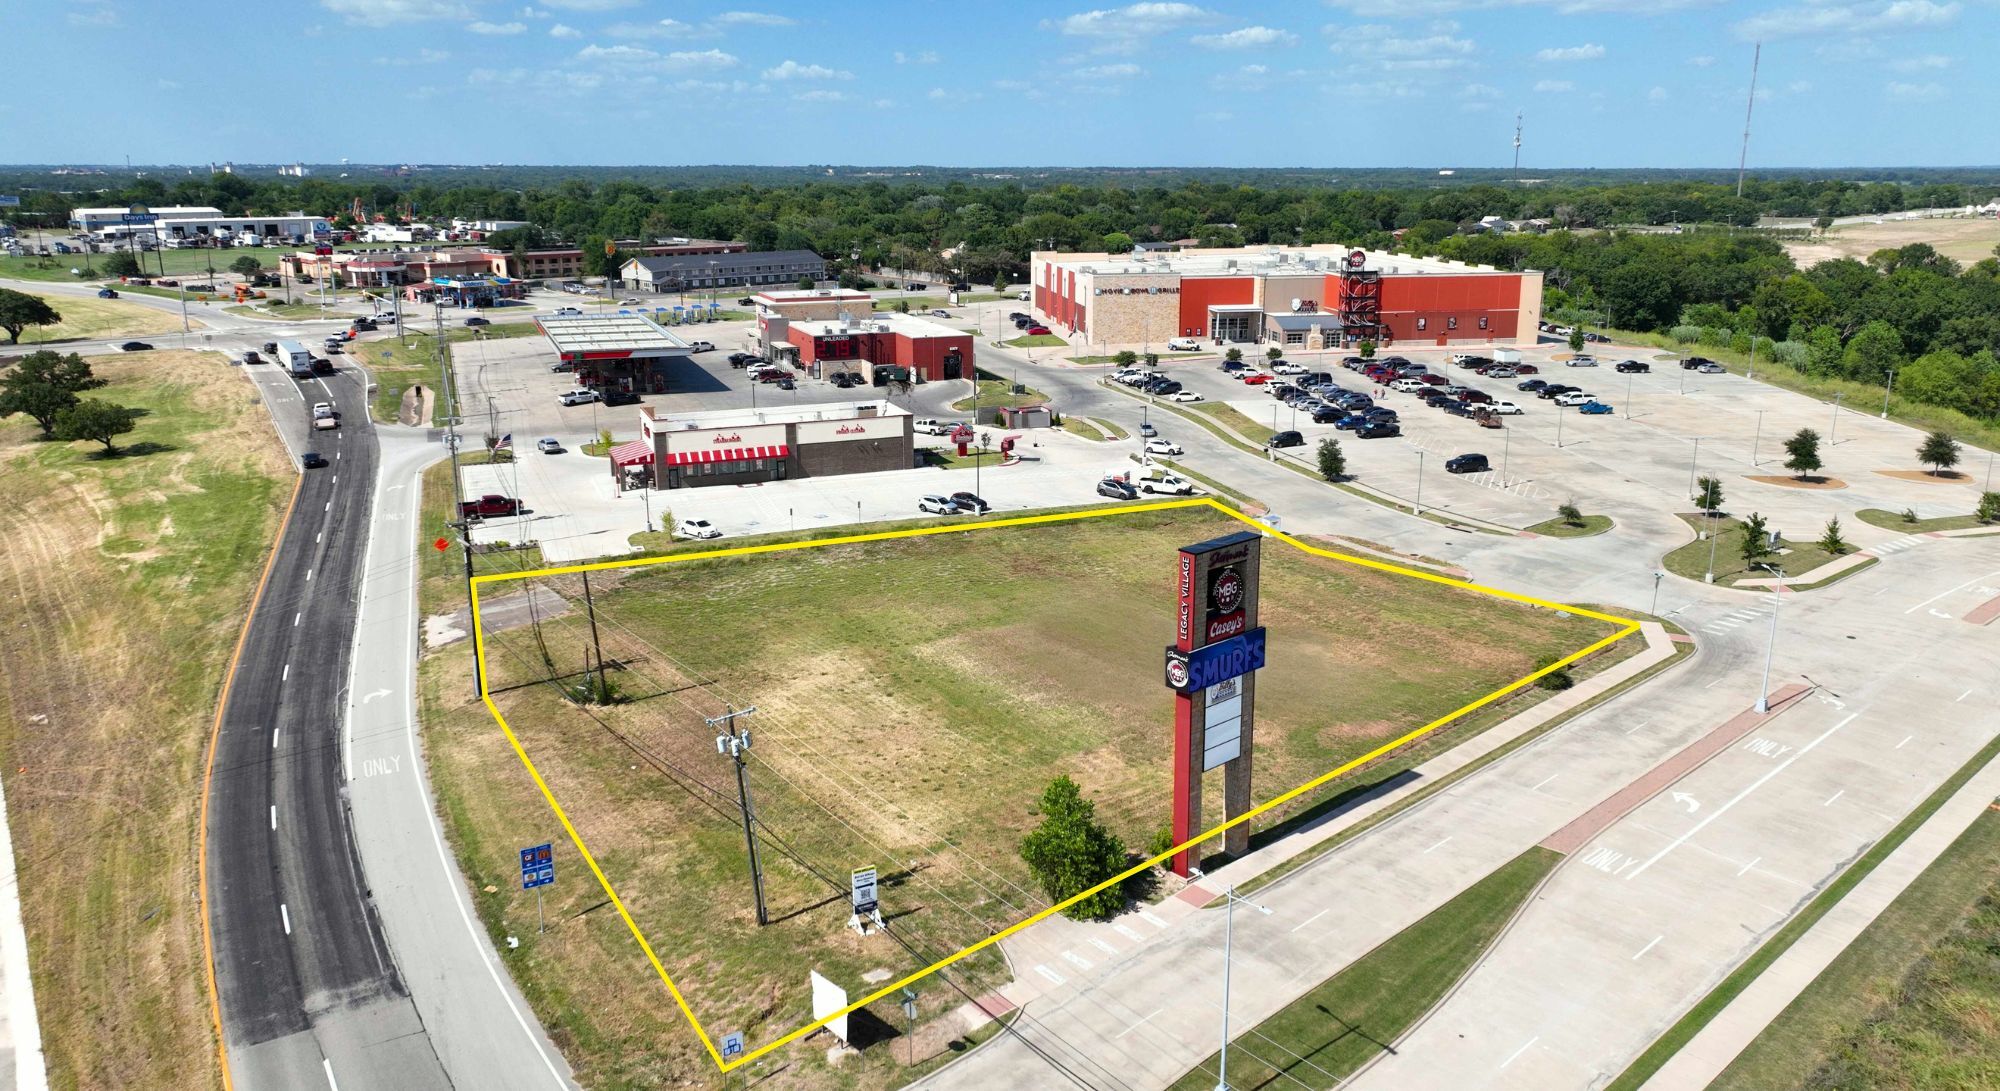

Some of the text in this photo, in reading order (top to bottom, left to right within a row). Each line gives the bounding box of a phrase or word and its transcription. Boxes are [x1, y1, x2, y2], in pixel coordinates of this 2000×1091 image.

[1101, 287, 1124, 295] MOVIE
[1180, 557, 1190, 640] LEGACY VILLAGE
[1218, 581, 1238, 599] MBG
[1210, 615, 1243, 638] Casey's
[1189, 638, 1265, 692] SMURFS
[1743, 738, 1793, 759] ONLY
[363, 754, 401, 778] ONLY
[1581, 847, 1640, 876] ONLY
